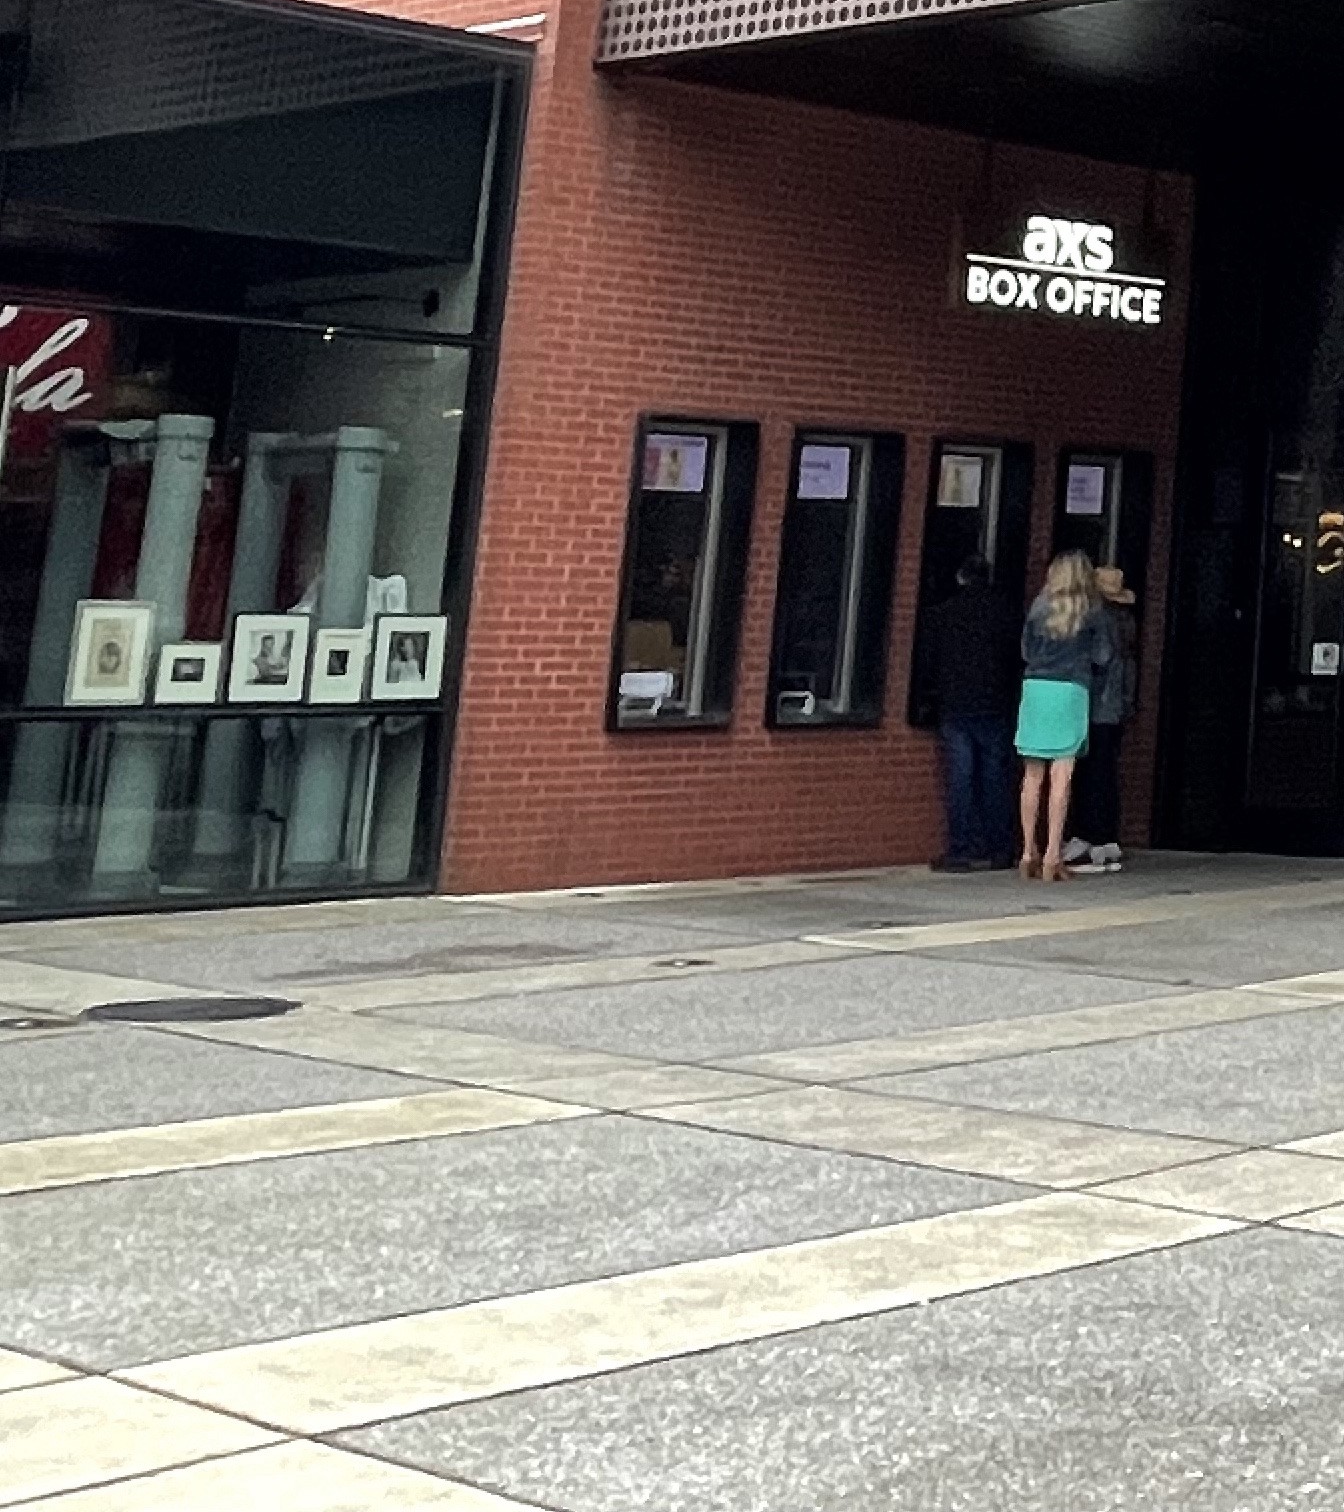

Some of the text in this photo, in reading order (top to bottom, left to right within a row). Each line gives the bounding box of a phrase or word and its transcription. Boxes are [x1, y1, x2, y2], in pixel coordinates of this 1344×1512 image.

[1023, 215, 1114, 272] axs
[966, 265, 1162, 324] BOX OFFICE
